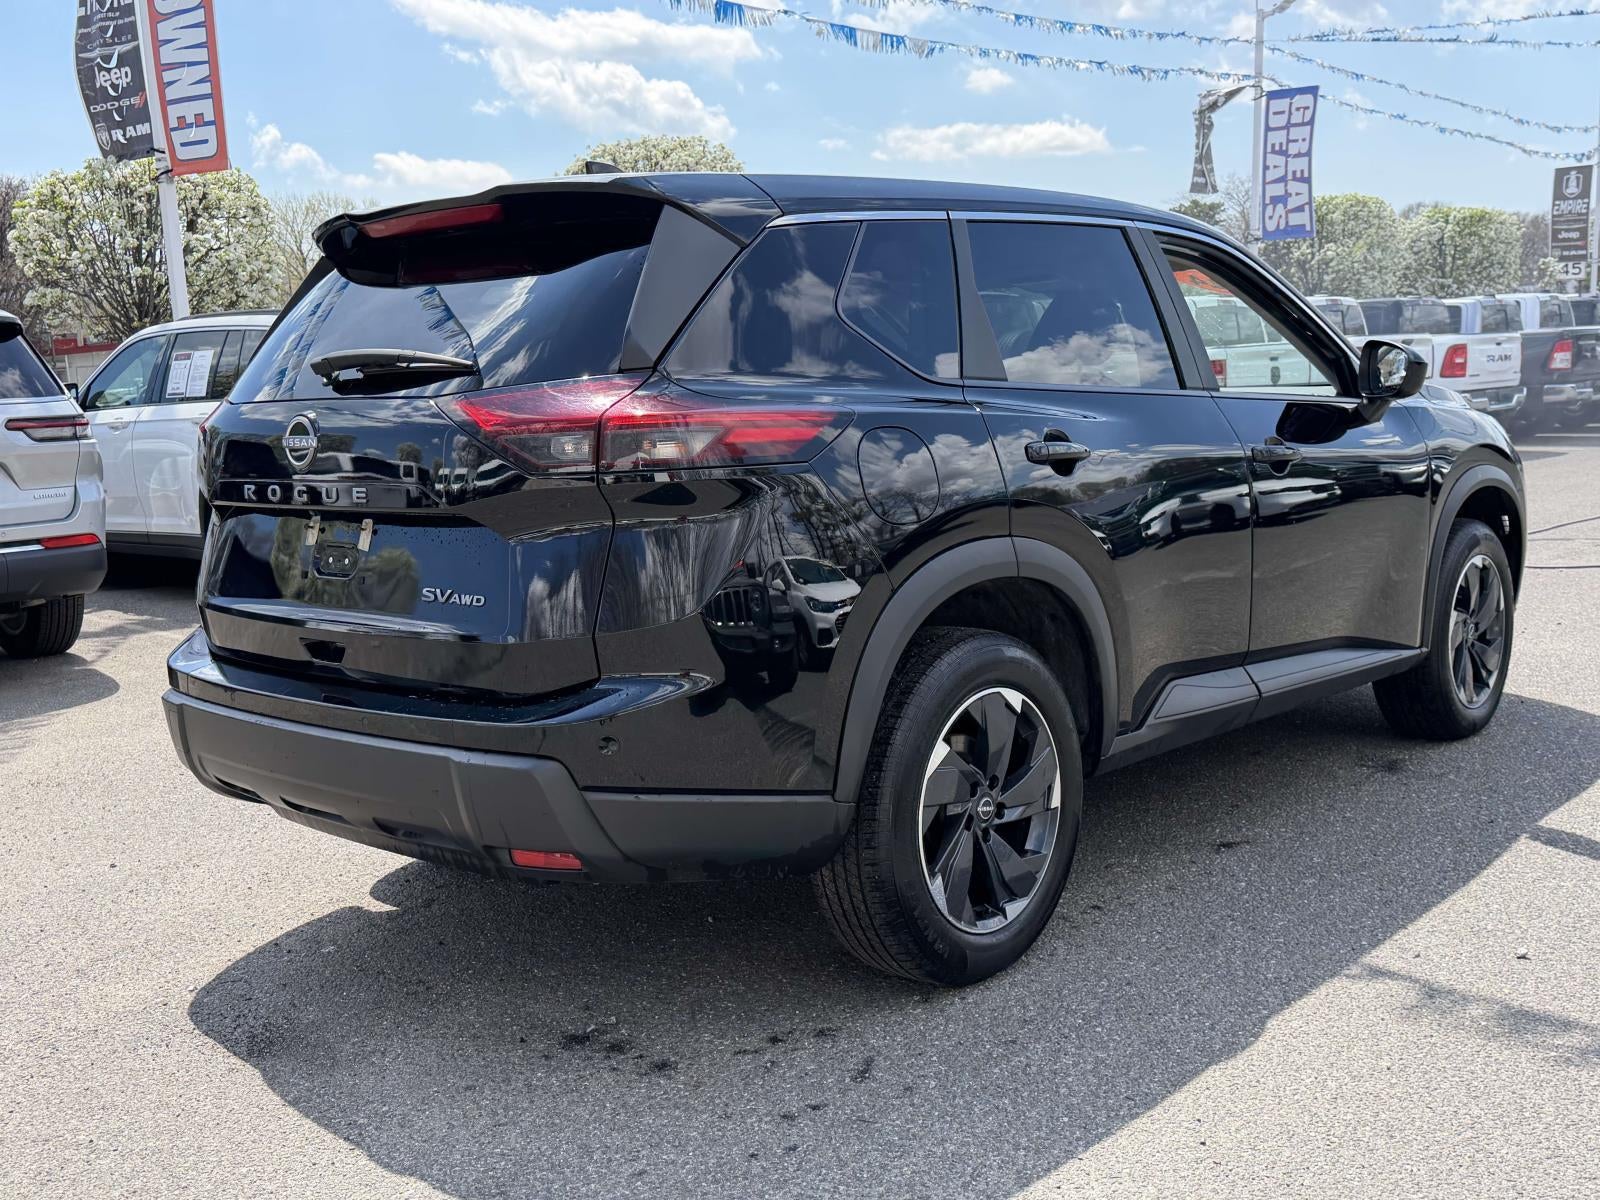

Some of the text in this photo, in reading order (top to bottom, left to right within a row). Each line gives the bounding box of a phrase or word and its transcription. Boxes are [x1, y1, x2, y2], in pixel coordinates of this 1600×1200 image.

[94, 66, 132, 89] Jeep
[90, 96, 140, 112] DODGE
[110, 122, 151, 141] RAM
[1264, 97, 1290, 232] DEALS
[1287, 94, 1315, 231] GREAT
[1553, 199, 1589, 215] EMPIRE
[1557, 230, 1580, 239] Jeep
[1560, 262, 1582, 275] 45
[1486, 354, 1512, 362] RAM
[282, 437, 317, 447] NISSAN
[243, 484, 370, 504] ROGUE
[421, 587, 485, 607] SV AWD
